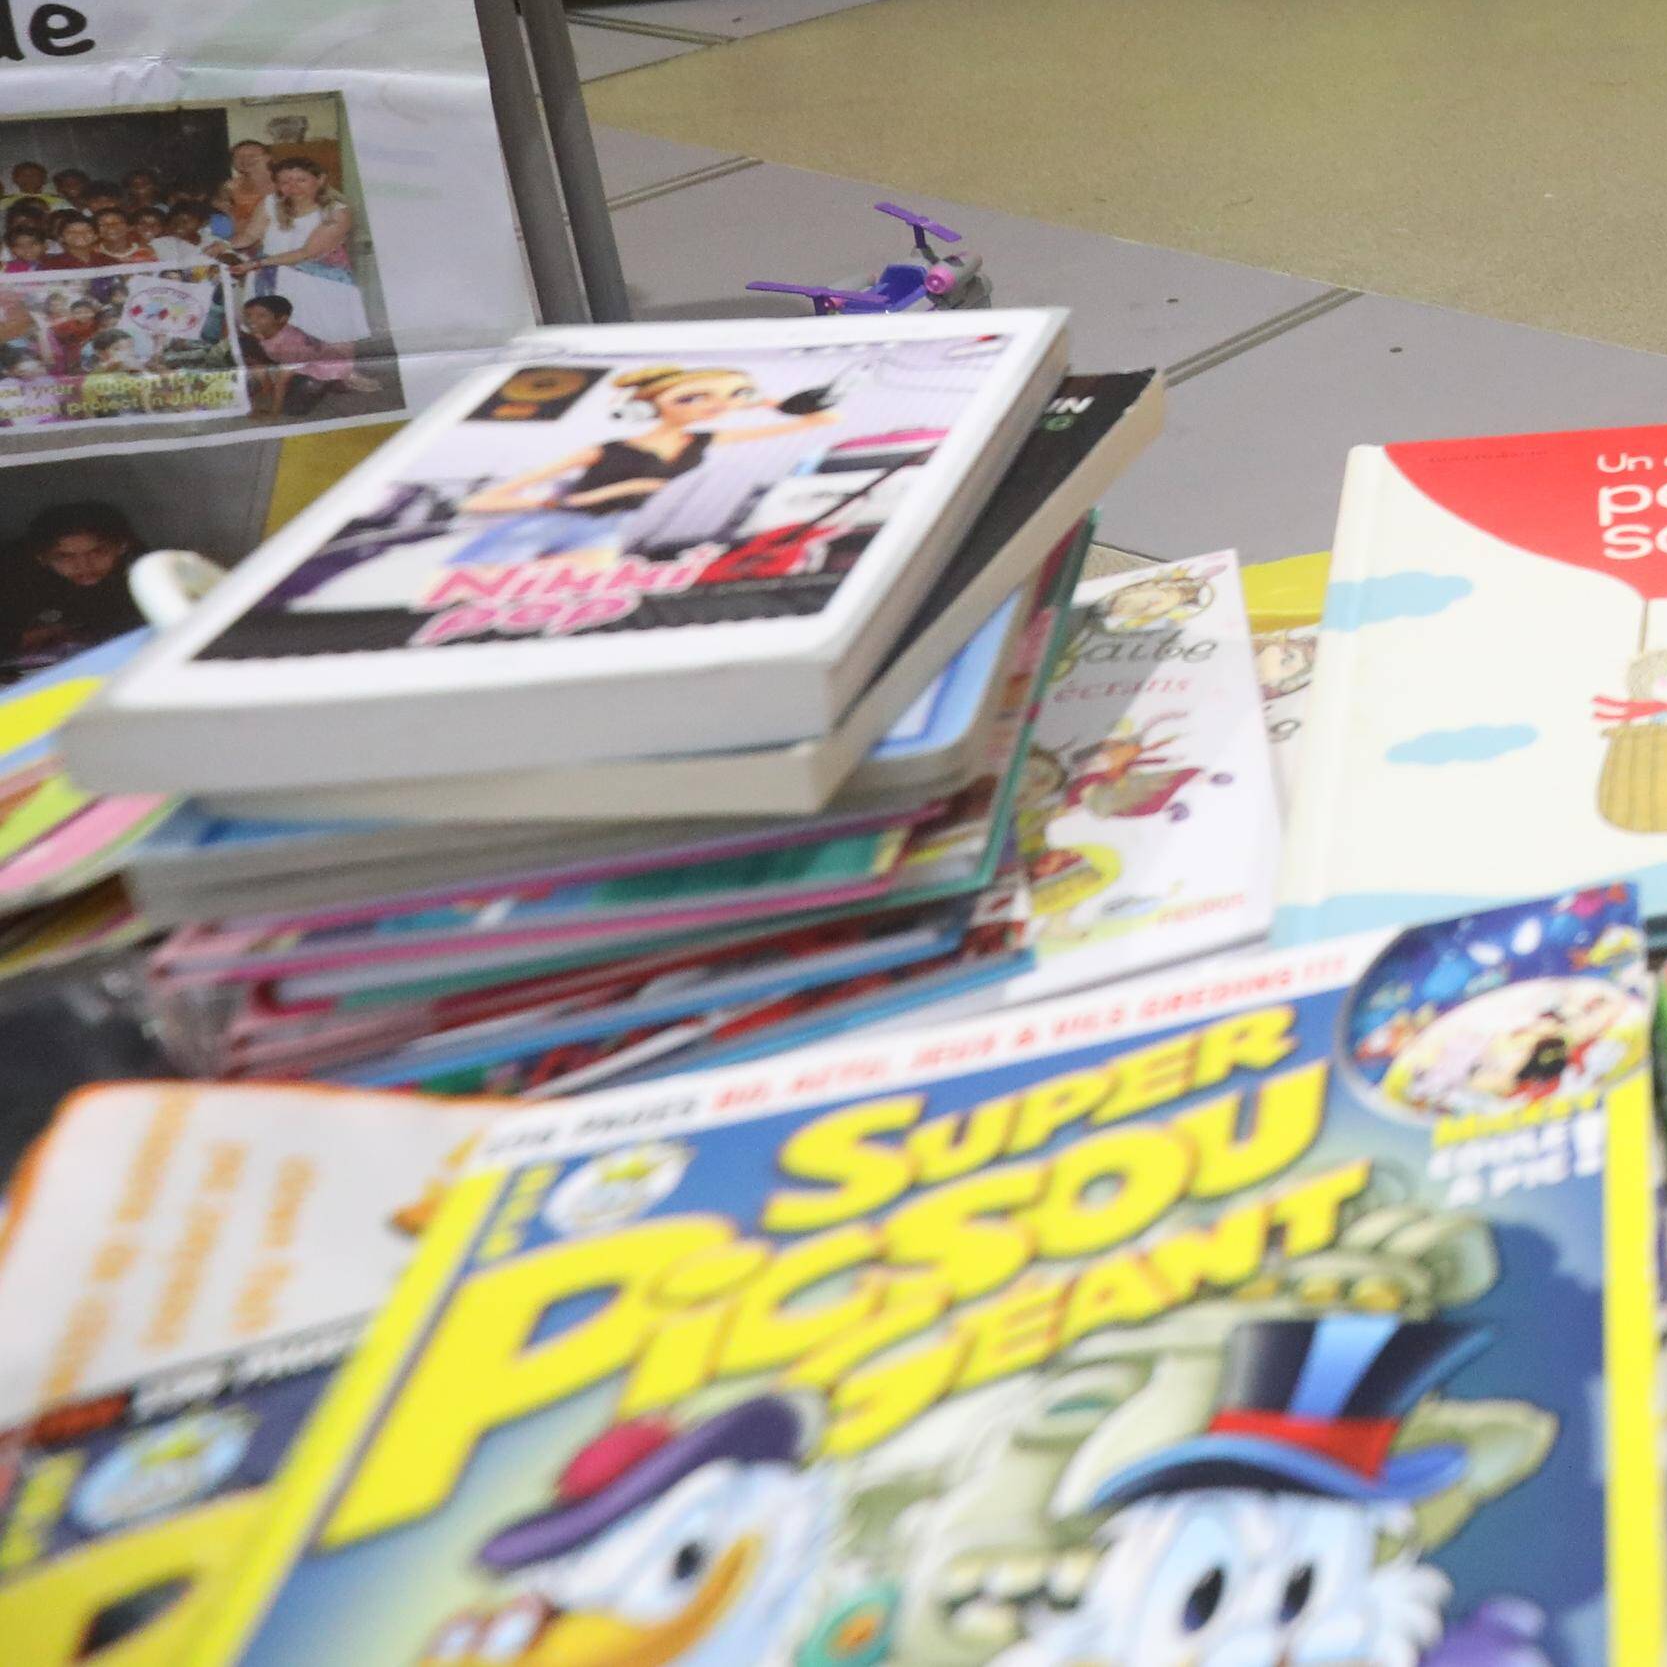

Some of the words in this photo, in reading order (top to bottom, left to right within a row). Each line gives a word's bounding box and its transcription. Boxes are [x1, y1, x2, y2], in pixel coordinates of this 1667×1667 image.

[1596, 451, 1654, 474] Un
[428, 535, 722, 605] Nikki
[412, 588, 645, 646] pop
[911, 1034, 1001, 1076] JEUX
[760, 1004, 1300, 1232] SUPER
[315, 1059, 1336, 1549] PICSOU
